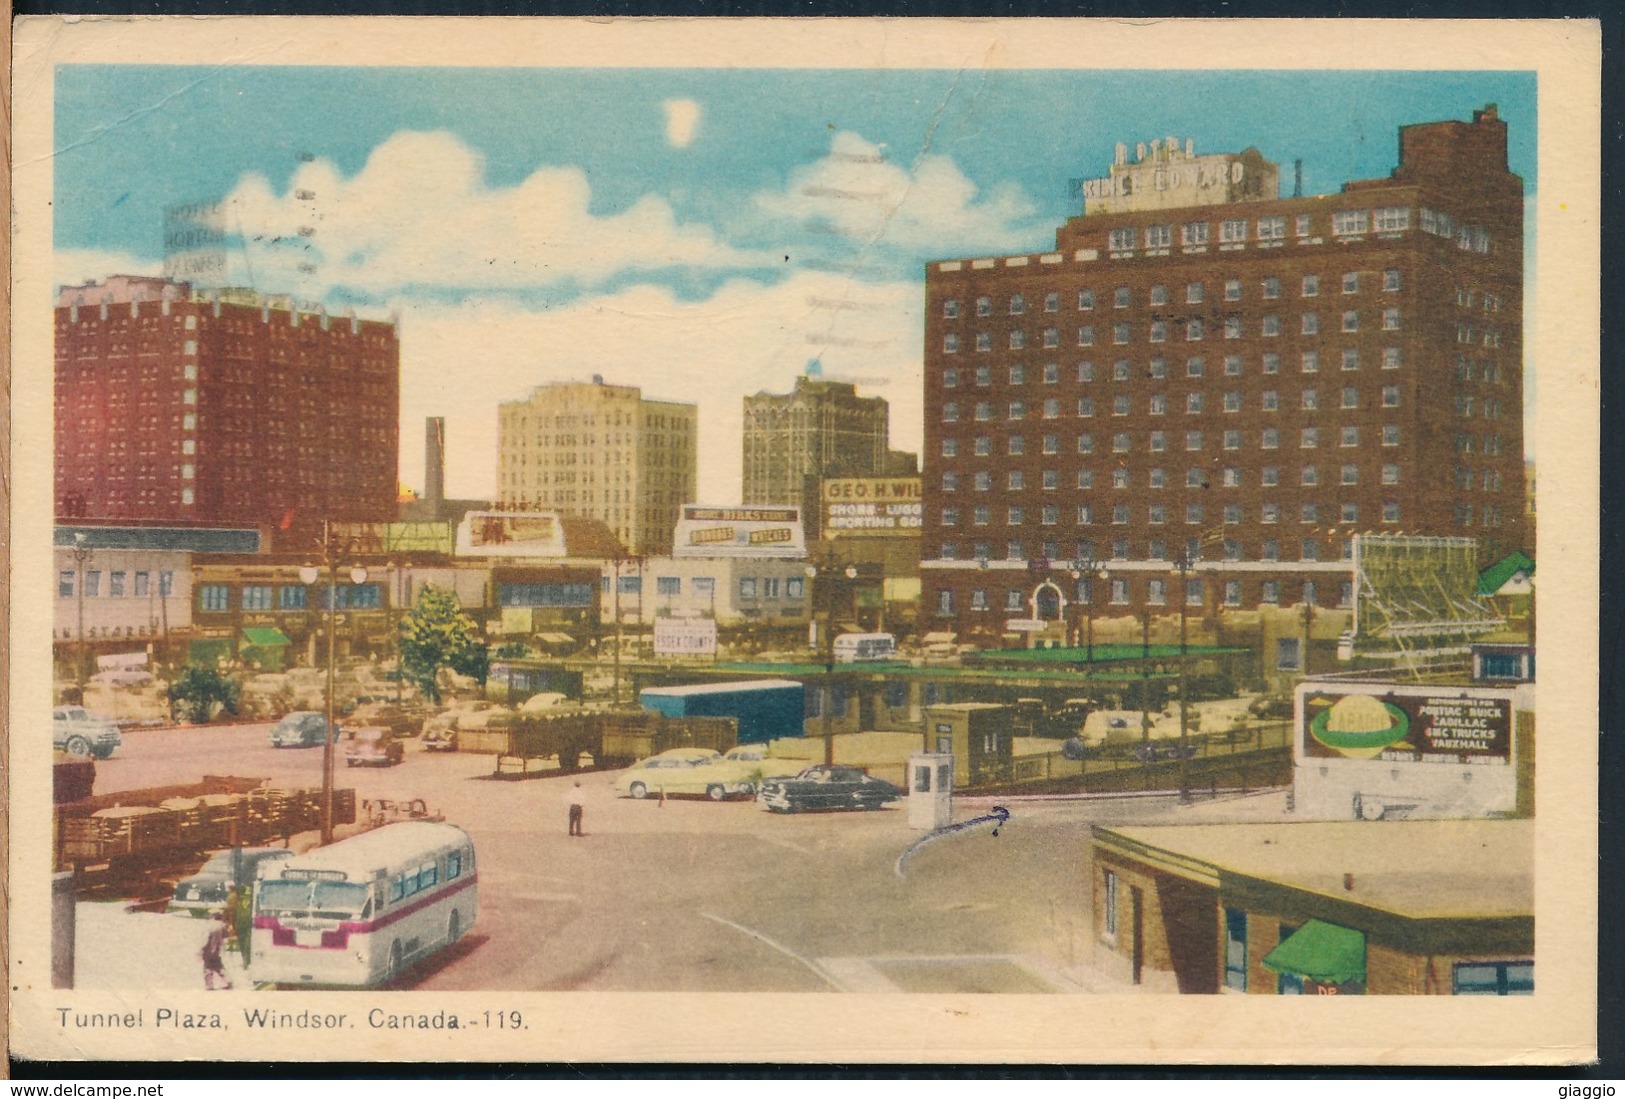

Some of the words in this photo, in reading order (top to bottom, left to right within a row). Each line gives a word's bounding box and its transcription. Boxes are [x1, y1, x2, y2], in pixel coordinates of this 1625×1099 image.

[1115, 136, 1195, 166] HOTEL
[829, 483, 872, 497] GEO.
[875, 483, 890, 497] H.
[1418, 705, 1462, 716] PONTIAC
[1469, 707, 1502, 717] BUICK
[1432, 716, 1487, 727] CADILLAC
[1451, 729, 1496, 739] TRUCKS
[56, 1008, 142, 1027] Tunnel
[156, 1008, 228, 1030] Plaza,
